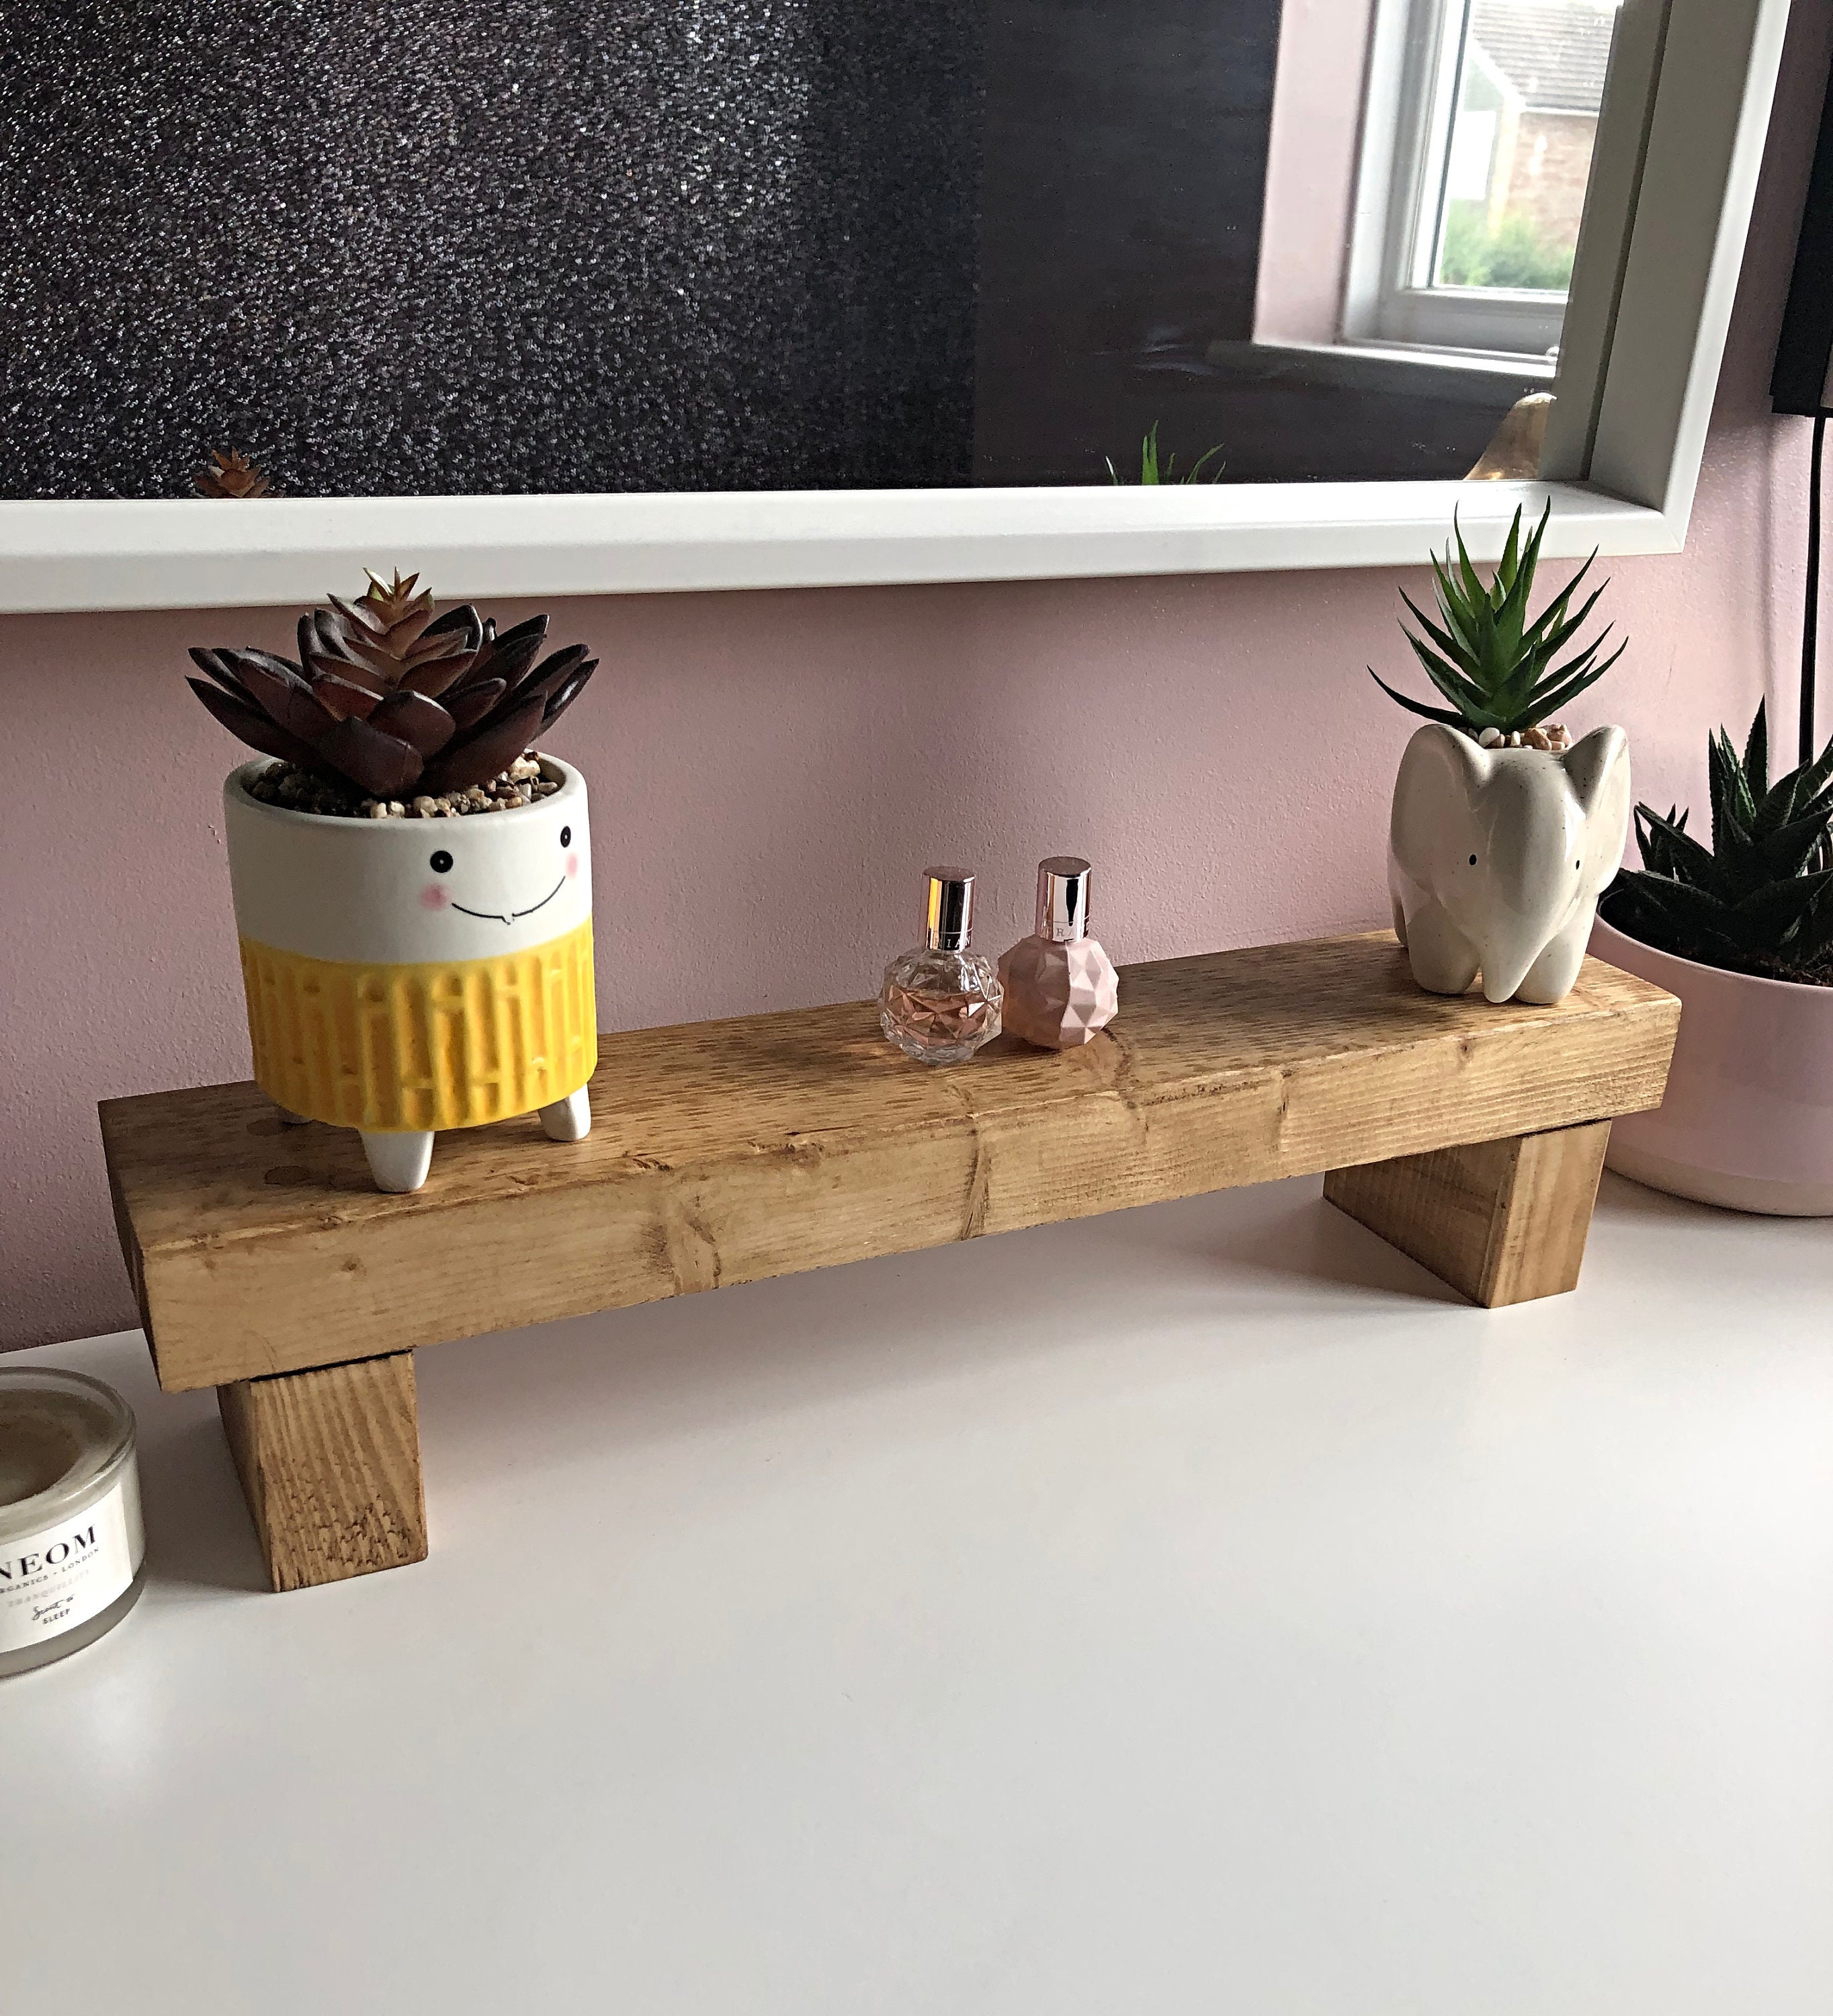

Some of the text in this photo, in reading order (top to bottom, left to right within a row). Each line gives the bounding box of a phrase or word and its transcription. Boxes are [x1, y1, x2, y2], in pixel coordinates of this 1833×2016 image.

[0, 1524, 96, 1579] NEOM
[61, 1546, 99, 1572] LONDON
[43, 1608, 71, 1625] SLEEP
